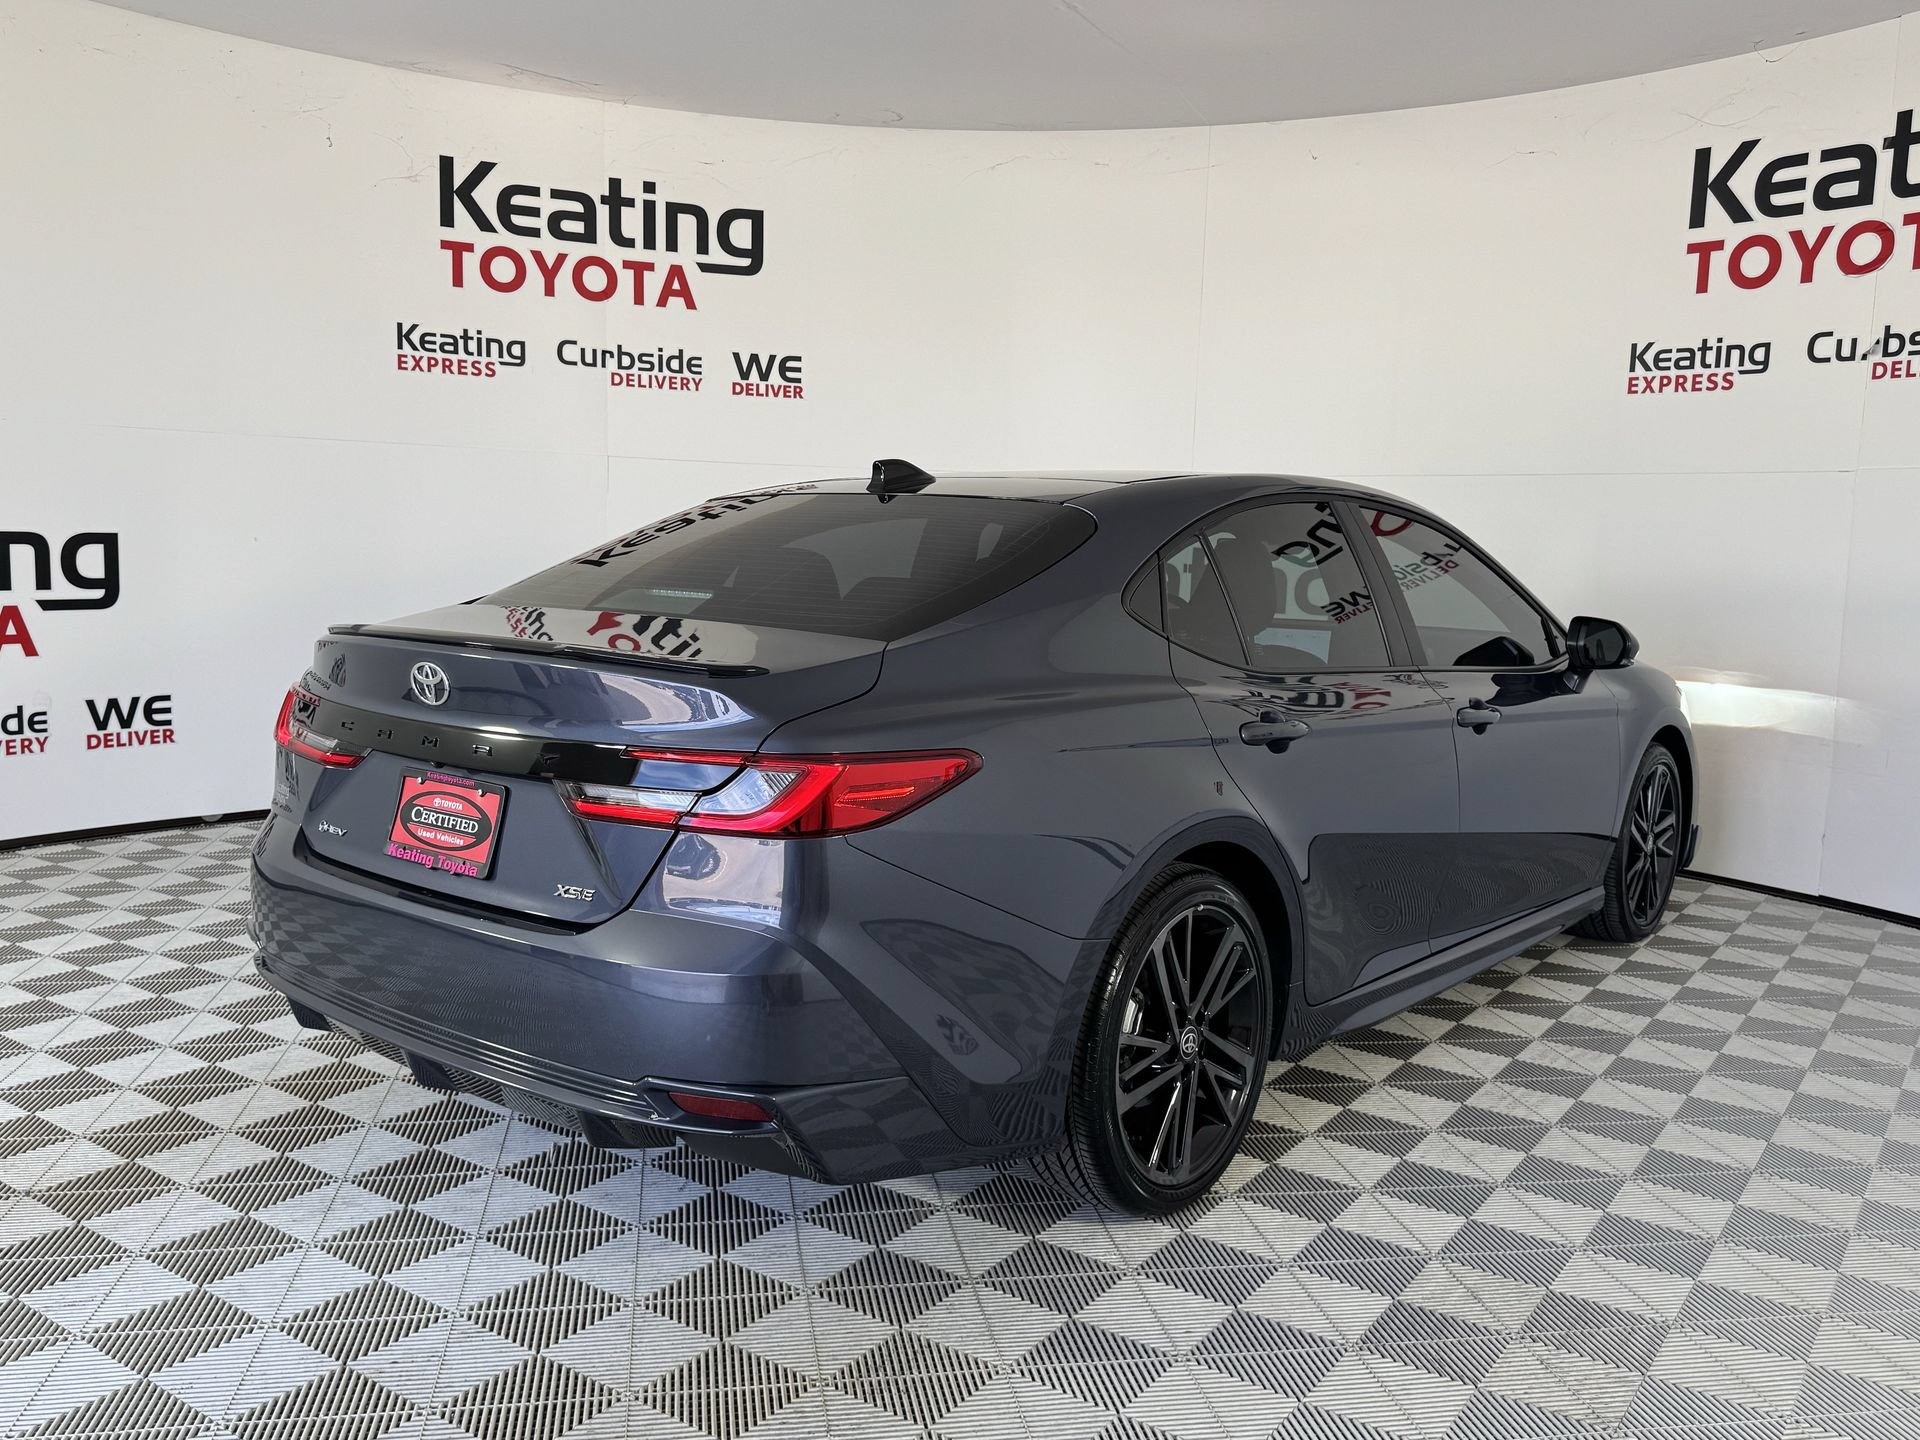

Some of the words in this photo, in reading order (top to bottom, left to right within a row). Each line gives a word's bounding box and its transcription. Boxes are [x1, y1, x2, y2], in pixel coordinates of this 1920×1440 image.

[439, 154, 764, 276] Keating
[440, 240, 698, 310] TOYOTA
[396, 321, 525, 367] Keating
[1629, 337, 1772, 375] Keating
[397, 353, 497, 378] EXPRESS
[556, 339, 703, 376] Curbside
[731, 351, 802, 384] WE
[1872, 360, 1920, 380] DEL
[610, 371, 703, 392] DELIVERY
[731, 382, 805, 400] DELIVER
[1627, 372, 1735, 395] EXPRESS
[85, 694, 172, 731] WE
[0, 735, 49, 756] ERY
[86, 728, 175, 750] DELIVER
[440, 799, 463, 810] TOYOTA
[411, 806, 479, 833] CERTIFIED
[417, 829, 435, 839] Used
[436, 833, 464, 846] Vehicles
[388, 843, 434, 868] Keating
[438, 855, 478, 877] Toyota
[553, 884, 596, 902] XSE
